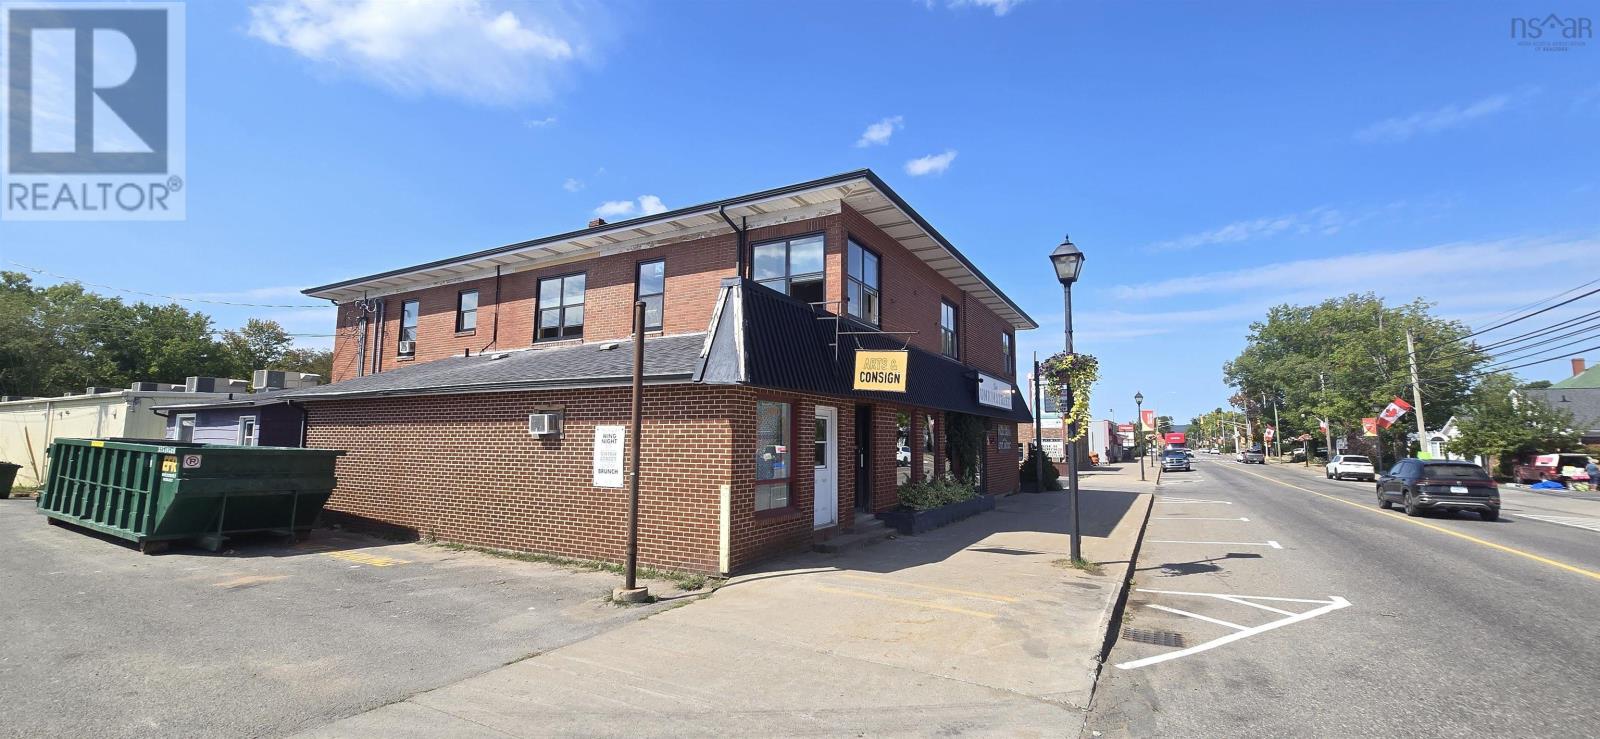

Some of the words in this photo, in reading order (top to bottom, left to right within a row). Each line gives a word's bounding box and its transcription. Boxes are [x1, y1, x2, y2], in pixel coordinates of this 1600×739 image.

[863, 357, 888, 371] ARTS
[890, 358, 898, 371] &
[860, 371, 901, 384] CONSIGN
